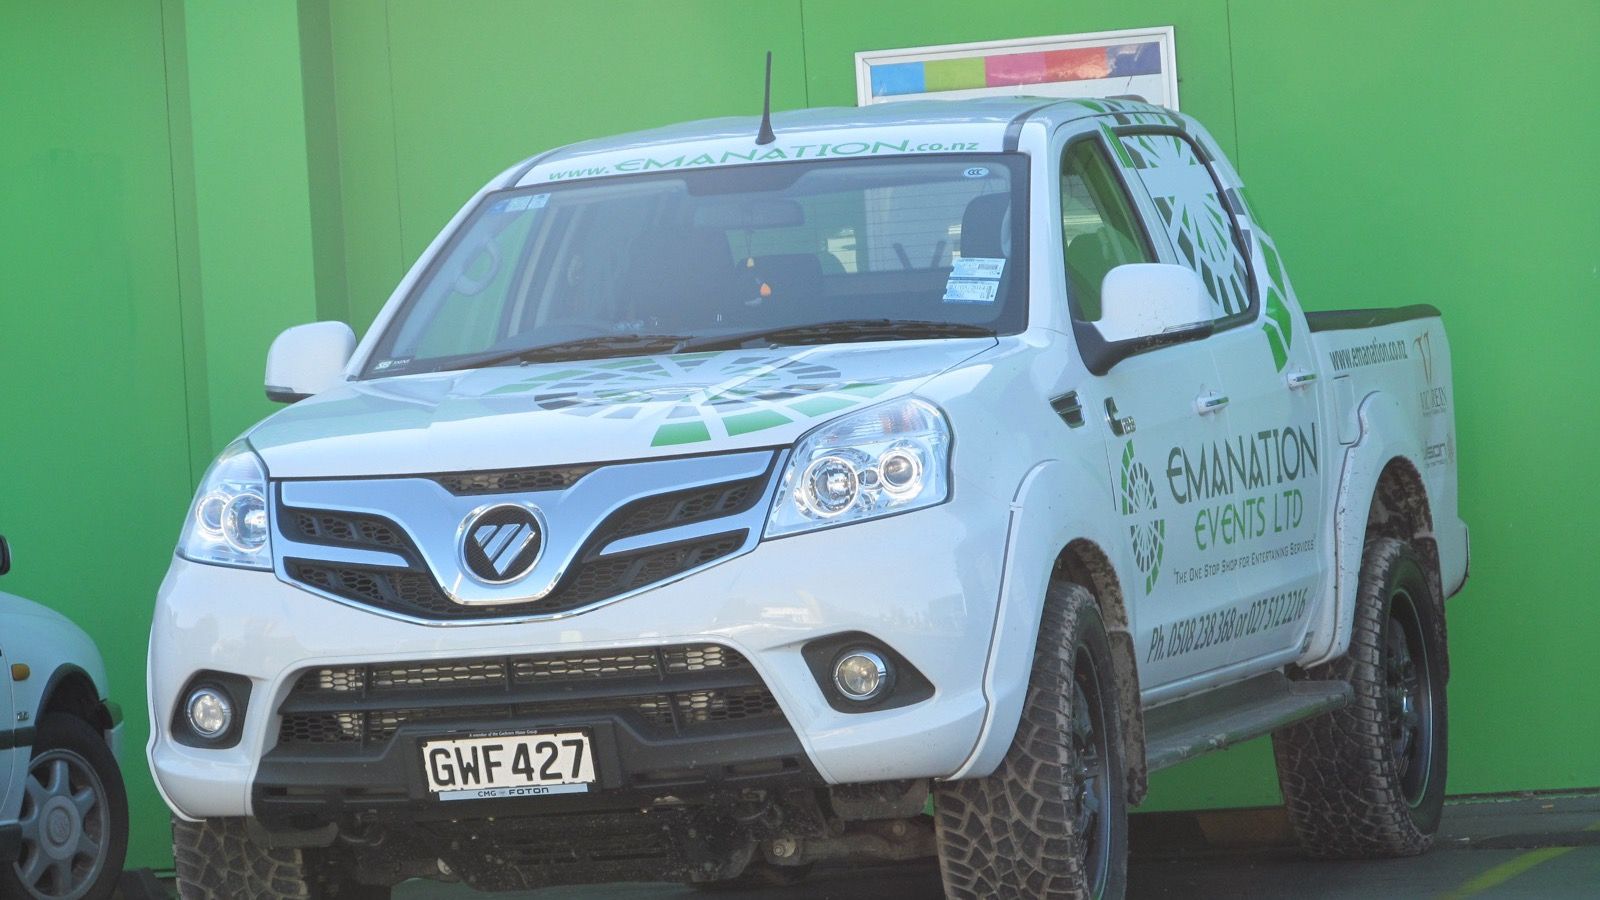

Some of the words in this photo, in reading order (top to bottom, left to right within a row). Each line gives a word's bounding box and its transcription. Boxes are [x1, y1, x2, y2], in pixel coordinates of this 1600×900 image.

[548, 138, 979, 181] www.EMANATION.co.nz
[1329, 336, 1409, 371] www.emanation.co.nz
[1166, 421, 1319, 504] EMANATION
[1194, 496, 1266, 551] EVENTS
[1273, 488, 1303, 534] LTD
[1189, 567, 1203, 582] ONE
[1204, 562, 1220, 578] STOP
[1221, 559, 1238, 573] SHOP
[1146, 624, 1164, 664] Ph.
[1167, 617, 1197, 658] 0508
[1194, 612, 1217, 650] 238
[1213, 607, 1237, 645] 368
[1234, 612, 1248, 639] or
[1246, 599, 1268, 636] 027
[1263, 592, 1285, 631] 512
[1281, 587, 1308, 625] 2216
[508, 787, 549, 795] FOTON
